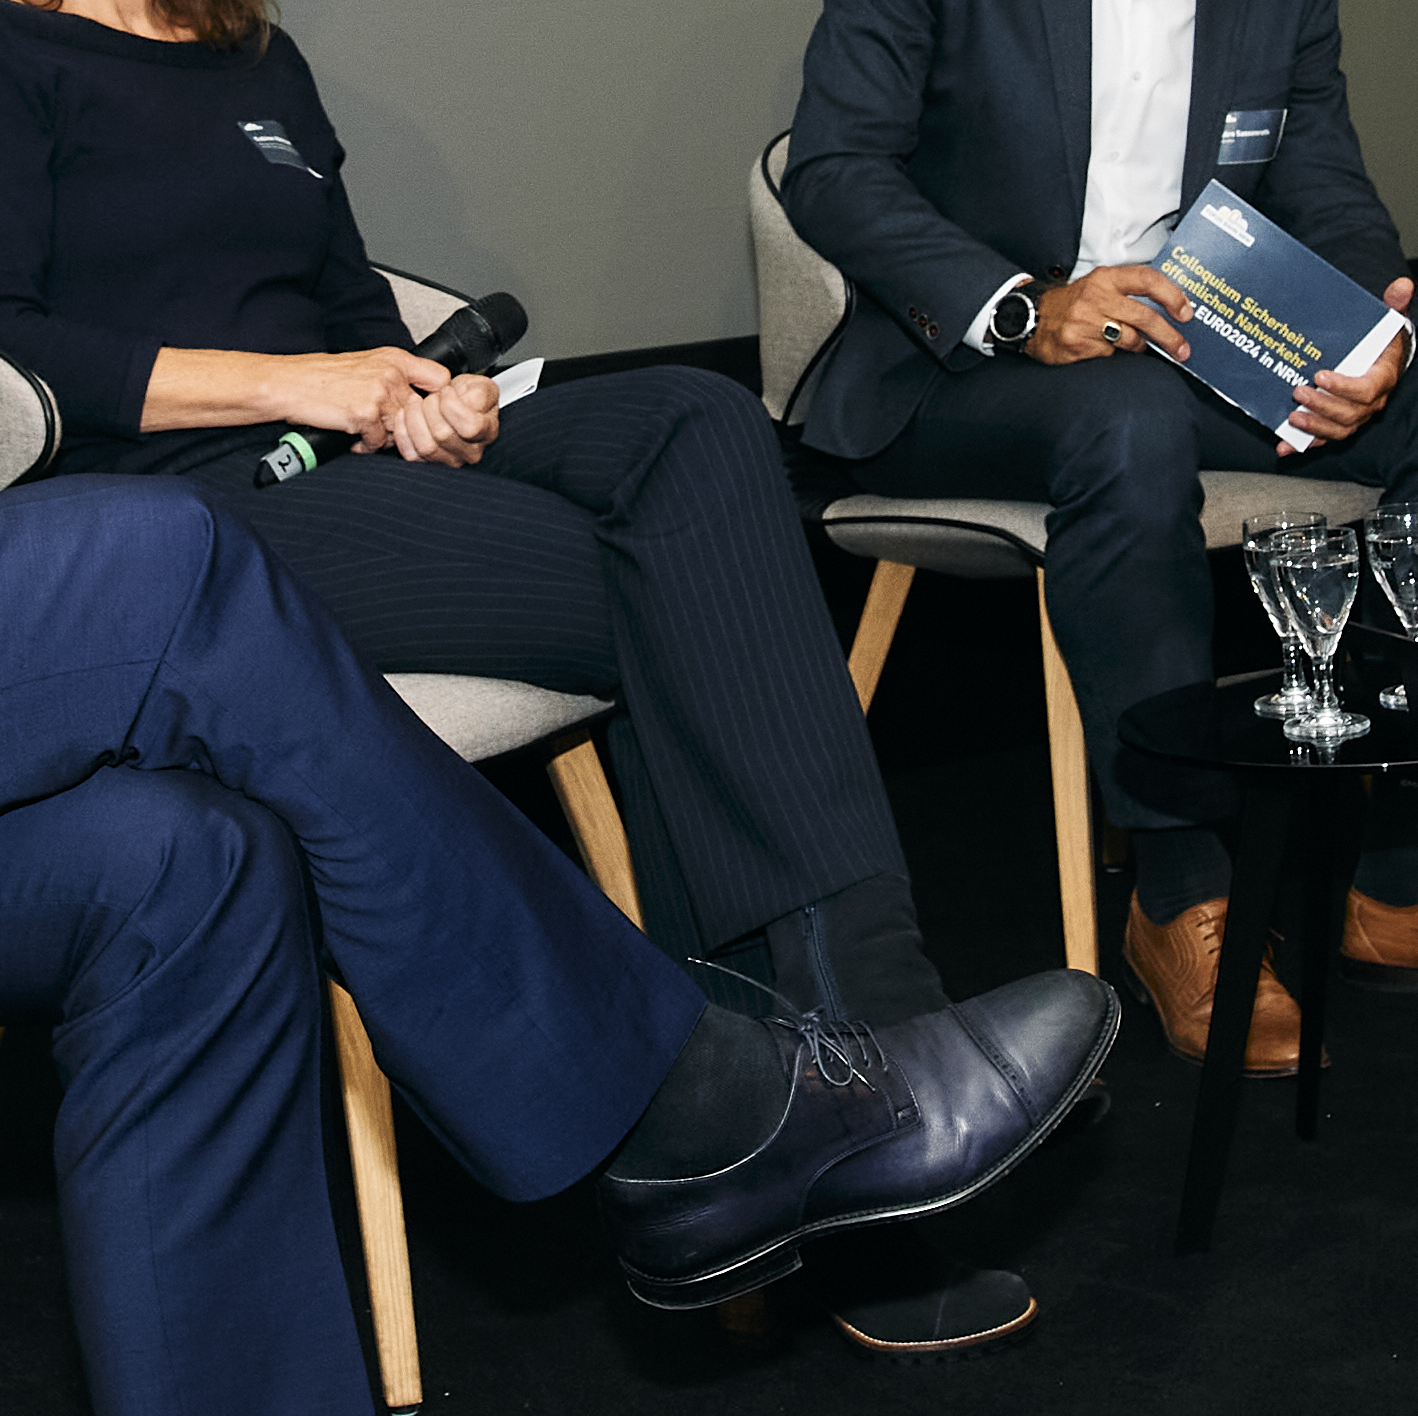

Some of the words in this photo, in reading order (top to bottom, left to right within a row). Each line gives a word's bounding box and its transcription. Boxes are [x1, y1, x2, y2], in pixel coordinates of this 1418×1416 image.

[1161, 259, 1235, 320] öffentlichen
[1234, 312, 1308, 369] Nahverkehr
[1171, 246, 1242, 304] Colloquium
[1240, 296, 1306, 349] Sicherheit
[1302, 341, 1322, 361] im
[1194, 304, 1262, 359] EURO2024
[1258, 351, 1275, 369] in
[1272, 360, 1310, 387] NRW
